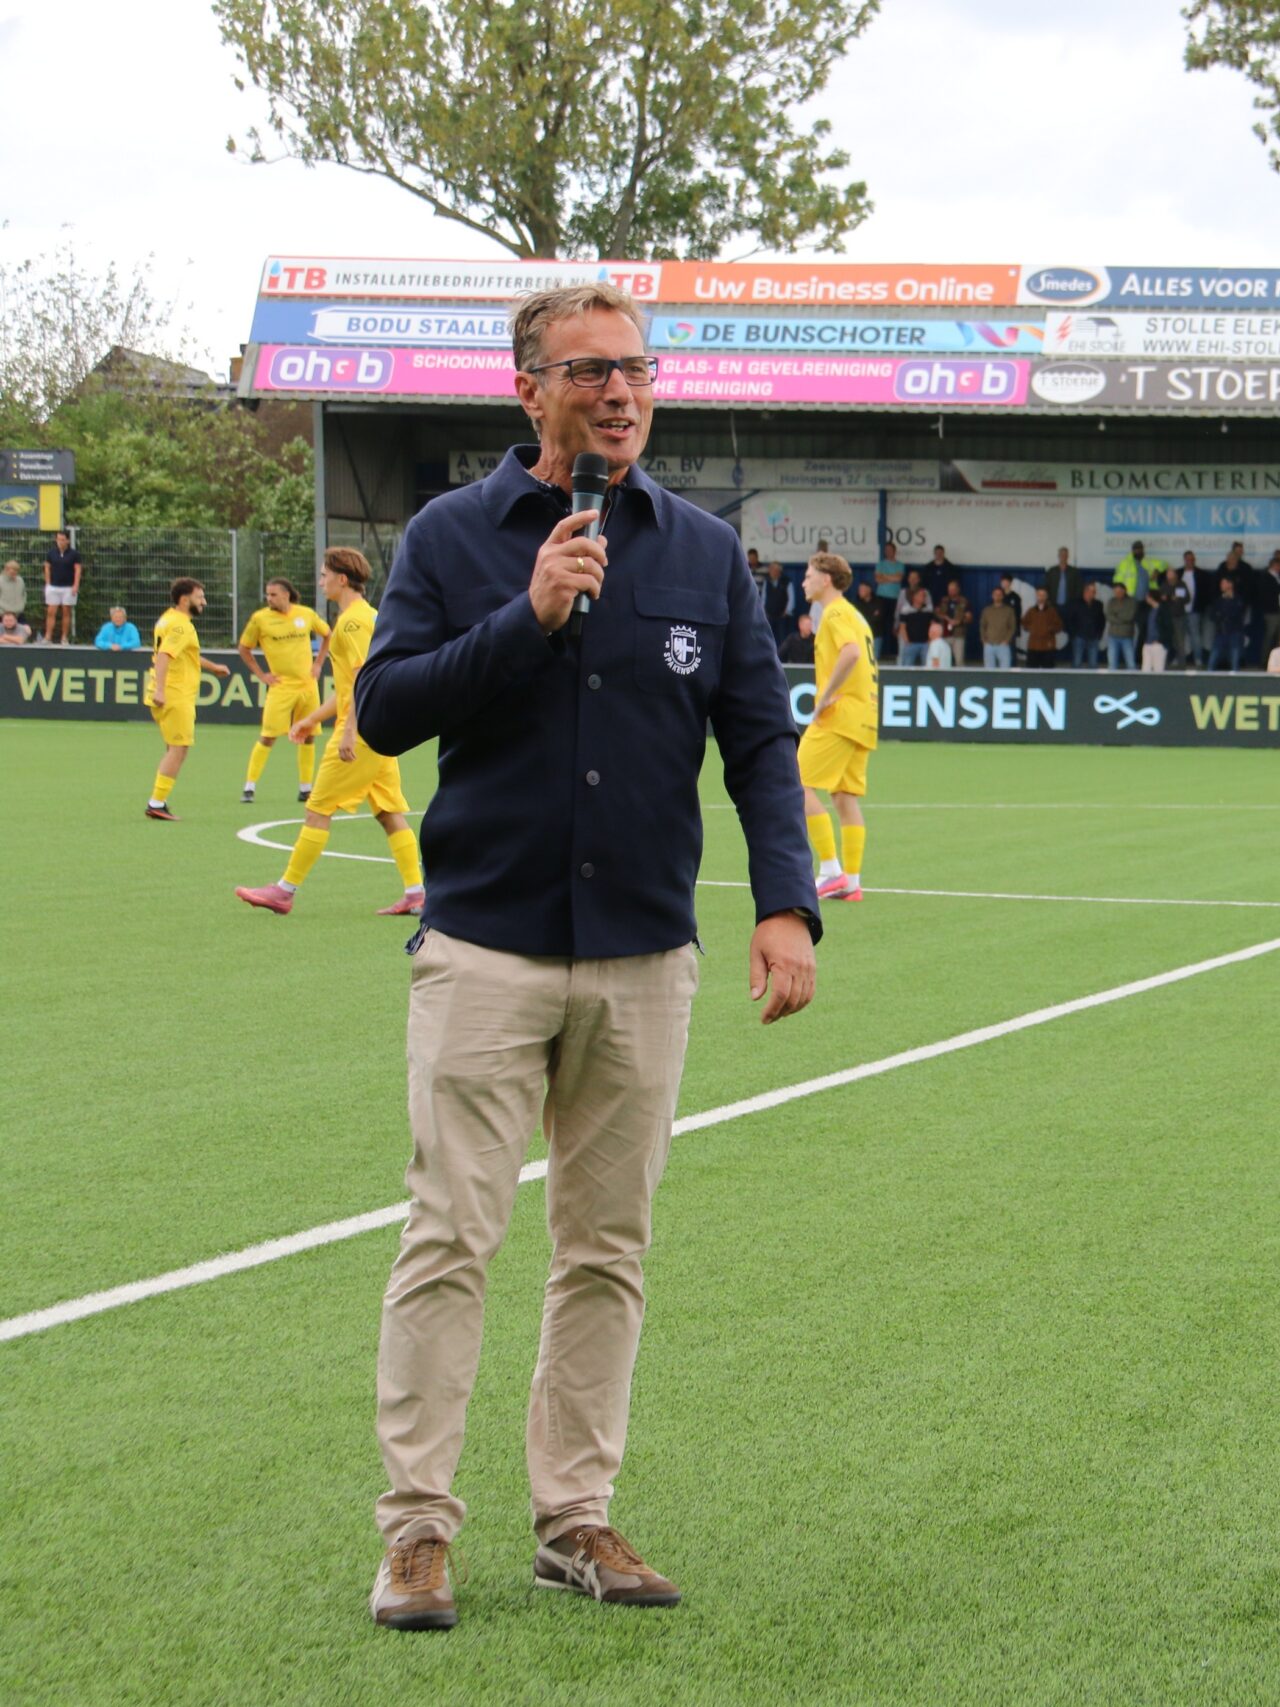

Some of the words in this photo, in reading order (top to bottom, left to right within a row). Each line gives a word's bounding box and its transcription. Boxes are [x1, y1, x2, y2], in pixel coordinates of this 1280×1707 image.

[694, 276, 746, 298] Uw
[752, 275, 888, 300] Business
[895, 277, 994, 302] Online
[1031, 271, 1093, 292] Smedes
[1120, 273, 1192, 296] ALLES
[1199, 277, 1268, 298] VOOR
[346, 317, 411, 333] BODU
[418, 319, 512, 337] STAALB
[702, 323, 736, 342] DE
[745, 324, 926, 346] BUNSCHOTER
[1145, 317, 1225, 335] STOLLE
[412, 354, 516, 371] SCHOONMA
[718, 361, 743, 375] EN
[747, 361, 893, 377] GEVELREINIGING
[682, 381, 773, 396] REINIGING
[681, 455, 705, 472] BV
[1111, 503, 1188, 526] SMINK
[1210, 503, 1261, 527] KOK
[772, 517, 866, 546] bureau
[663, 652, 702, 675] SPAKENBURG
